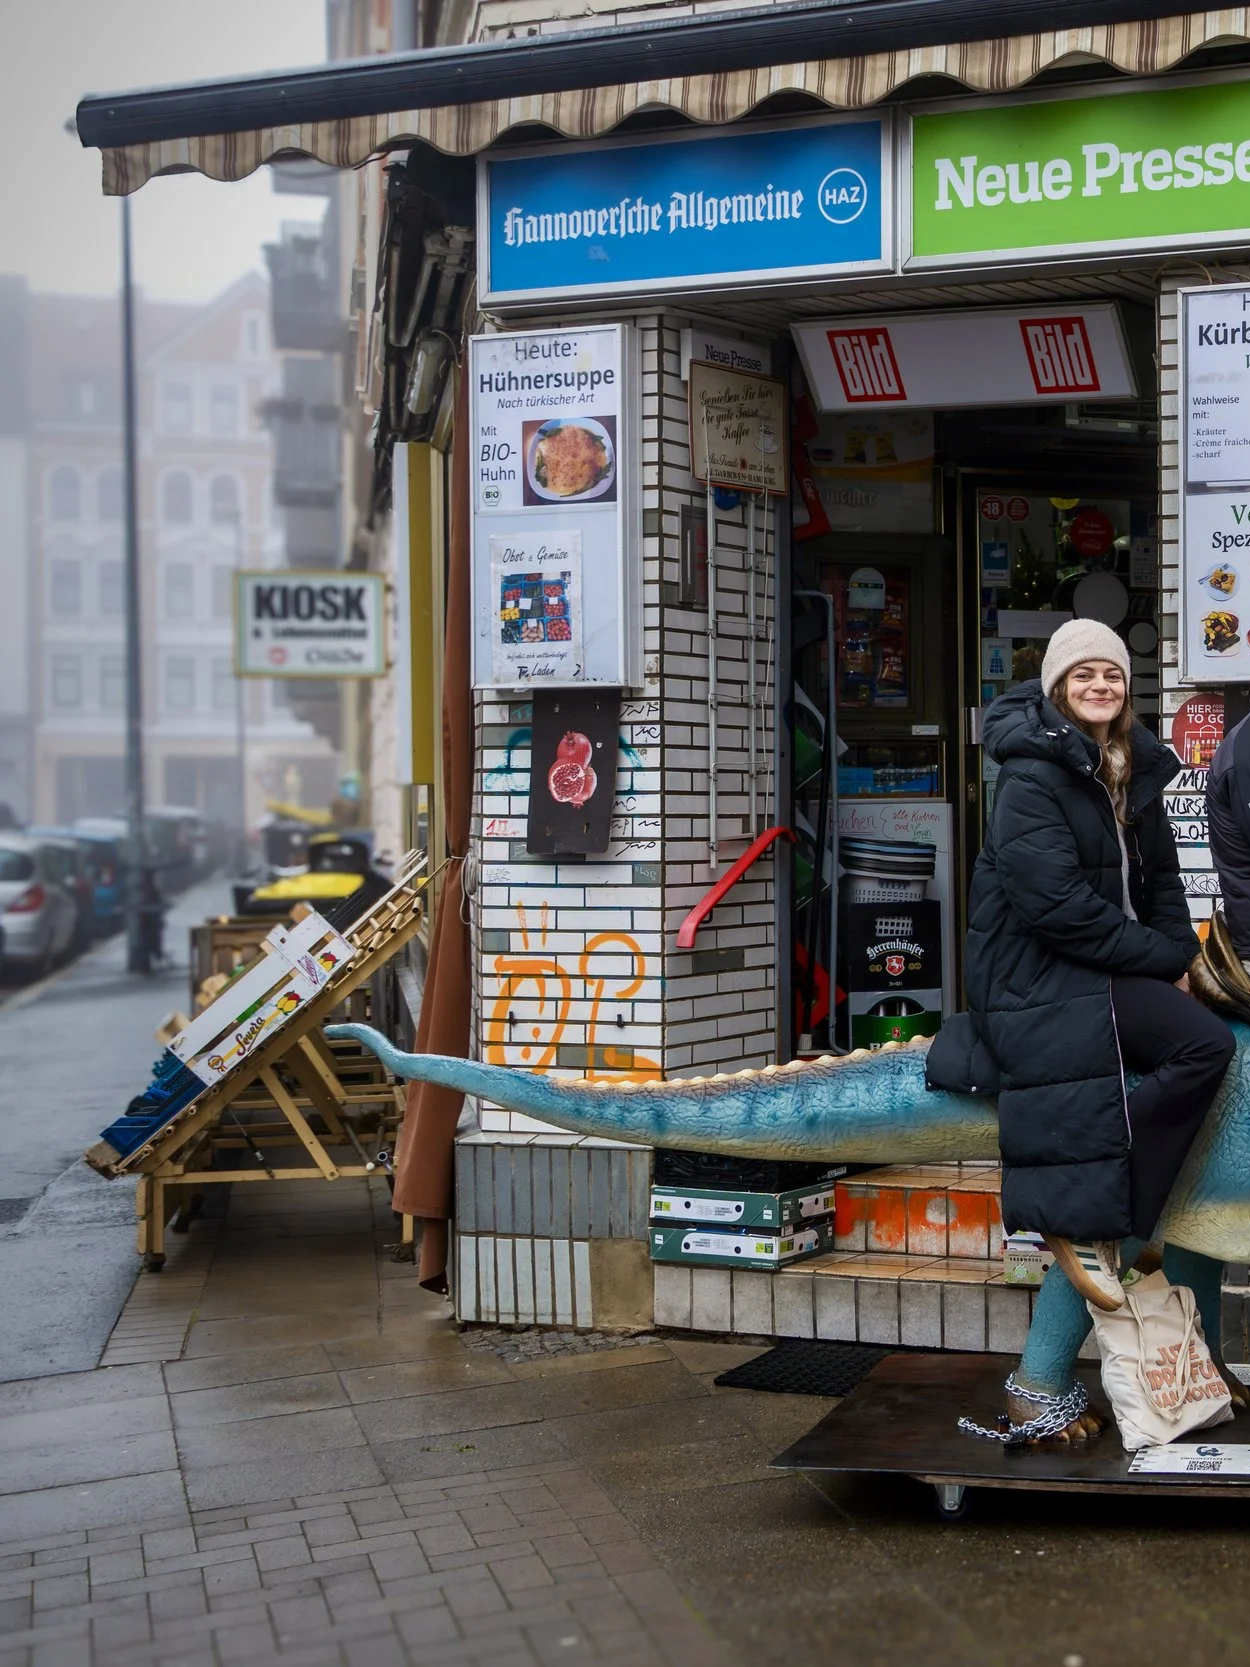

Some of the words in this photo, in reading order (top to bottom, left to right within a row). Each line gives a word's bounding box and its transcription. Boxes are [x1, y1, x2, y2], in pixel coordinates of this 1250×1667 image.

[934, 156, 1072, 210] Neue
[825, 185, 860, 205] HAZ
[667, 184, 804, 234] Allgemeine
[515, 341, 578, 361] Heute:
[705, 344, 730, 364] Neue
[731, 350, 762, 371] Presse
[1026, 323, 1093, 388] Bild
[833, 334, 900, 396] Bild
[480, 369, 615, 393] Hühnersuppe
[497, 398, 523, 409] Nach
[526, 394, 576, 407] türkischer
[578, 392, 595, 403] Art
[1192, 395, 1239, 406] Wahlweise
[1192, 411, 1209, 420] mit:
[481, 426, 497, 437] Mit
[722, 424, 750, 445] Kaffee
[481, 443, 516, 462] BIO-
[481, 467, 516, 482] Huhn
[503, 548, 524, 564] Obst
[537, 546, 568, 564] Gemüse
[254, 586, 366, 621] KIOSK
[531, 663, 555, 677] Laden
[1187, 704, 1211, 713] HIER
[1187, 714, 1206, 723] TO
